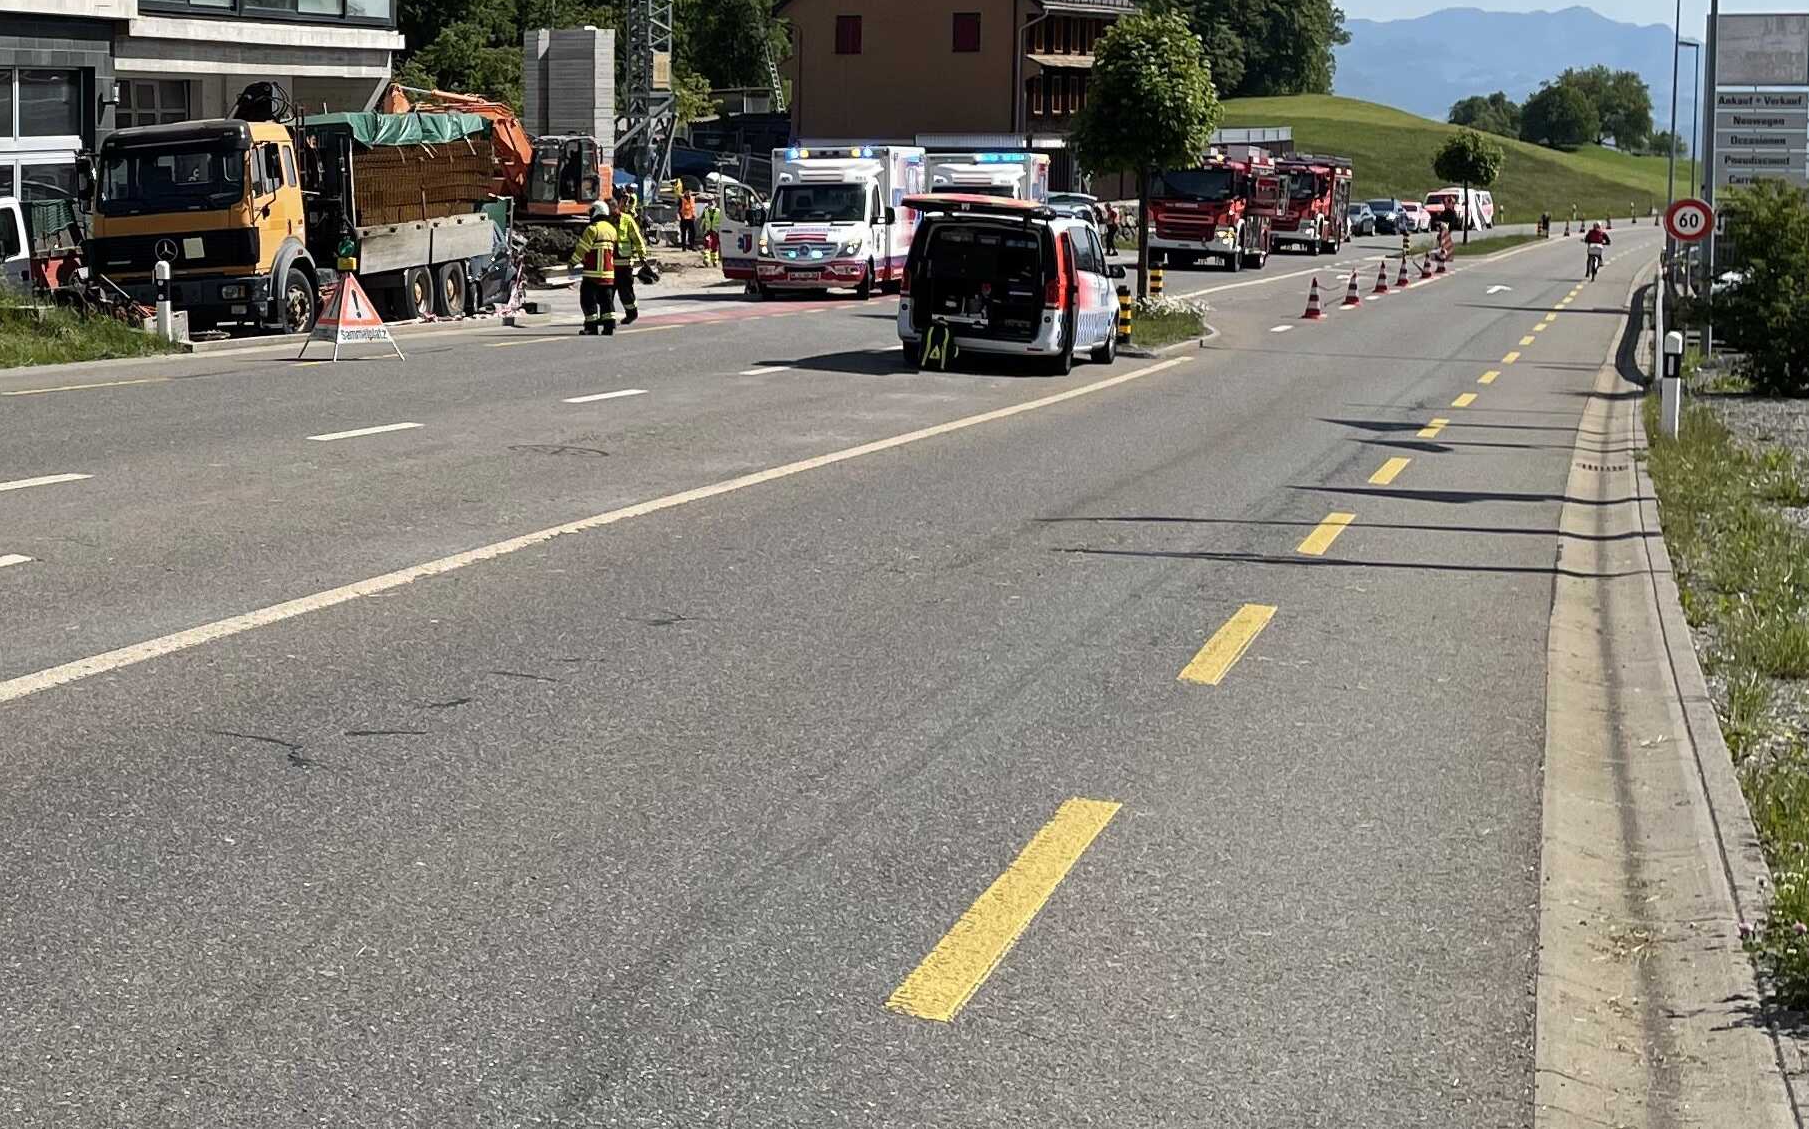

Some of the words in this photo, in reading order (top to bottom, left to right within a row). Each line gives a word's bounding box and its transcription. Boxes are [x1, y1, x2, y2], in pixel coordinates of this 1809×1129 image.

[1718, 95, 1753, 105] Ankauf
[1764, 95, 1802, 105] Verkauf
[1732, 116, 1785, 128] Neuwagen
[1730, 135, 1787, 145] Occasionen
[1679, 212, 1699, 229] 60
